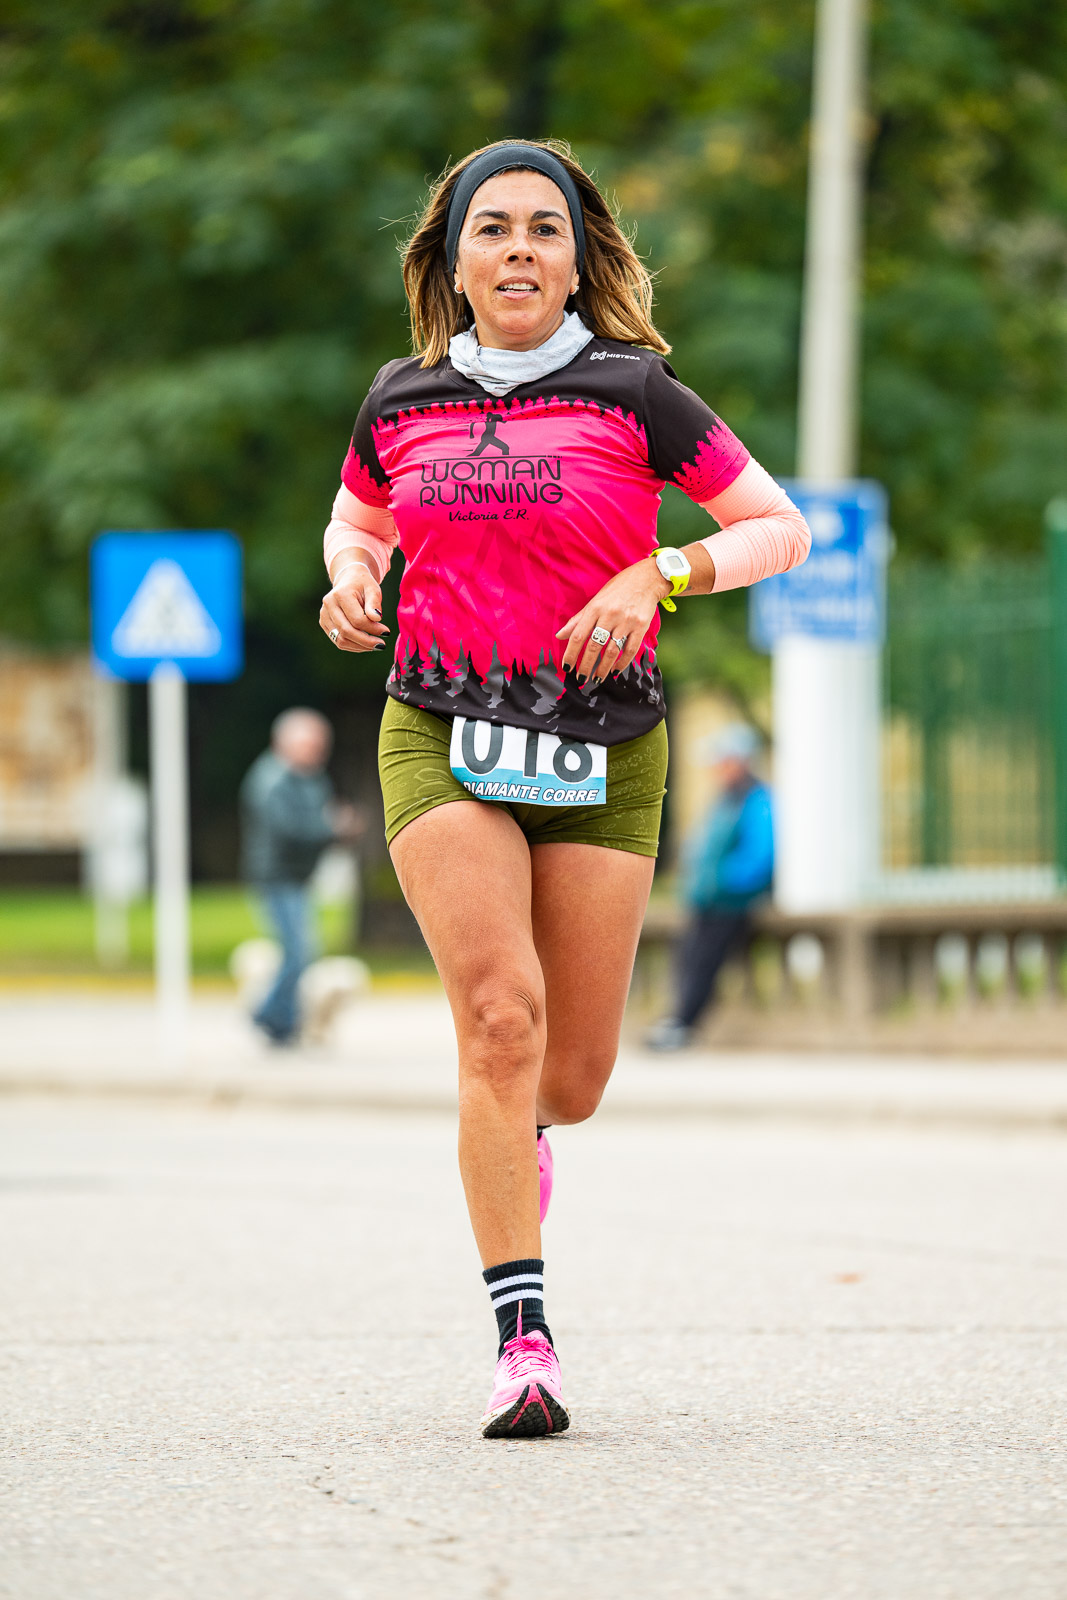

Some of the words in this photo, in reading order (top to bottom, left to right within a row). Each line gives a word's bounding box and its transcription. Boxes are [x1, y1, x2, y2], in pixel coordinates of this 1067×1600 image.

[420, 458, 562, 484] WOMAN
[419, 482, 564, 508] RUNNING
[448, 510, 500, 522] Victoria
[502, 508, 530, 521] E.R.
[542, 787, 599, 803] CORRE
